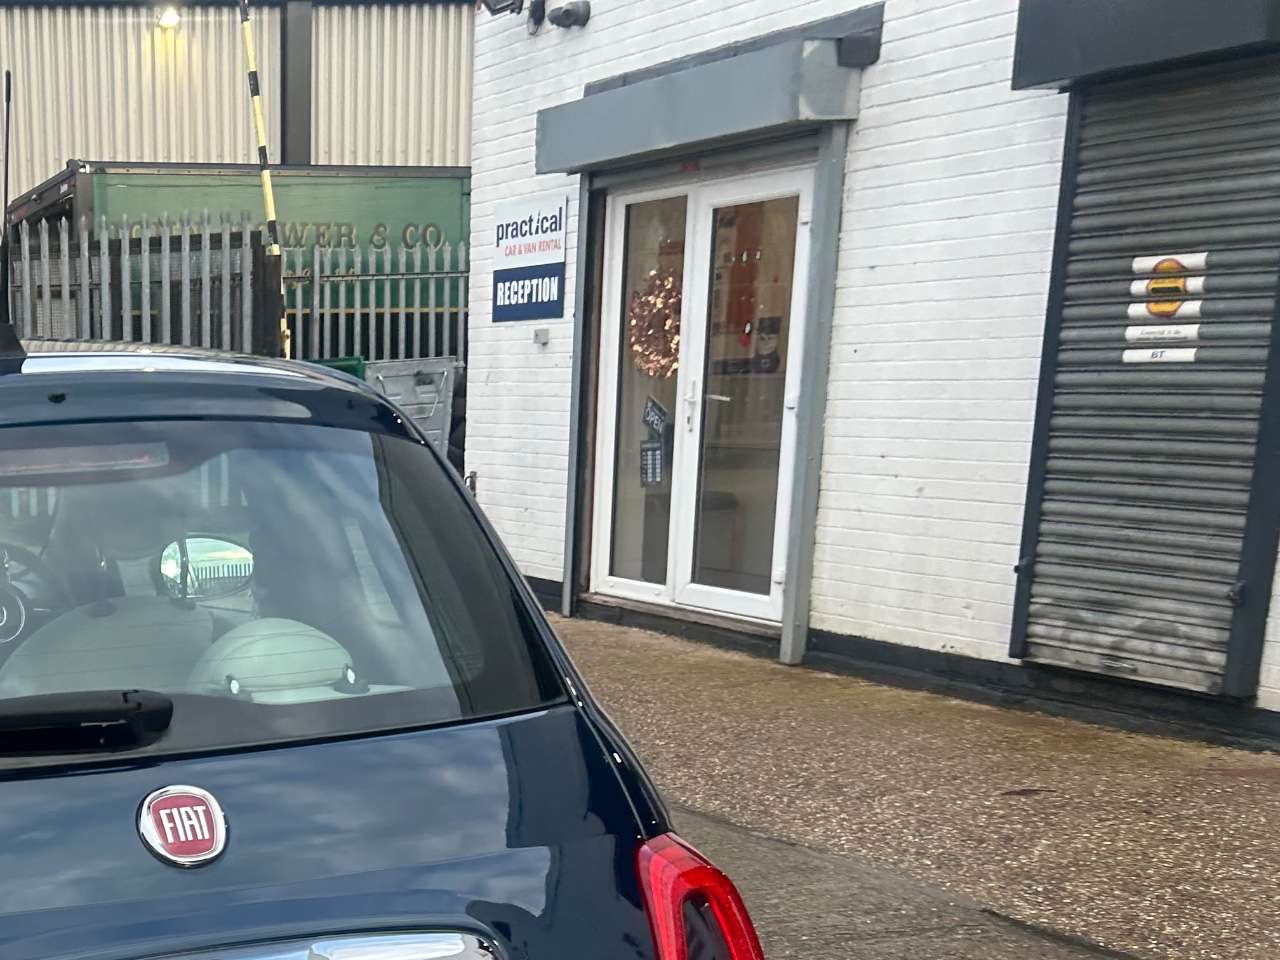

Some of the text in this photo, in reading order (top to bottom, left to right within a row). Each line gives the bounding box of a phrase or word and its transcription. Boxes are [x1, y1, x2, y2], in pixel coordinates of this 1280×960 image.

[496, 206, 562, 247] practical
[496, 276, 559, 306] RECEPTION
[159, 806, 210, 843] FIAT
